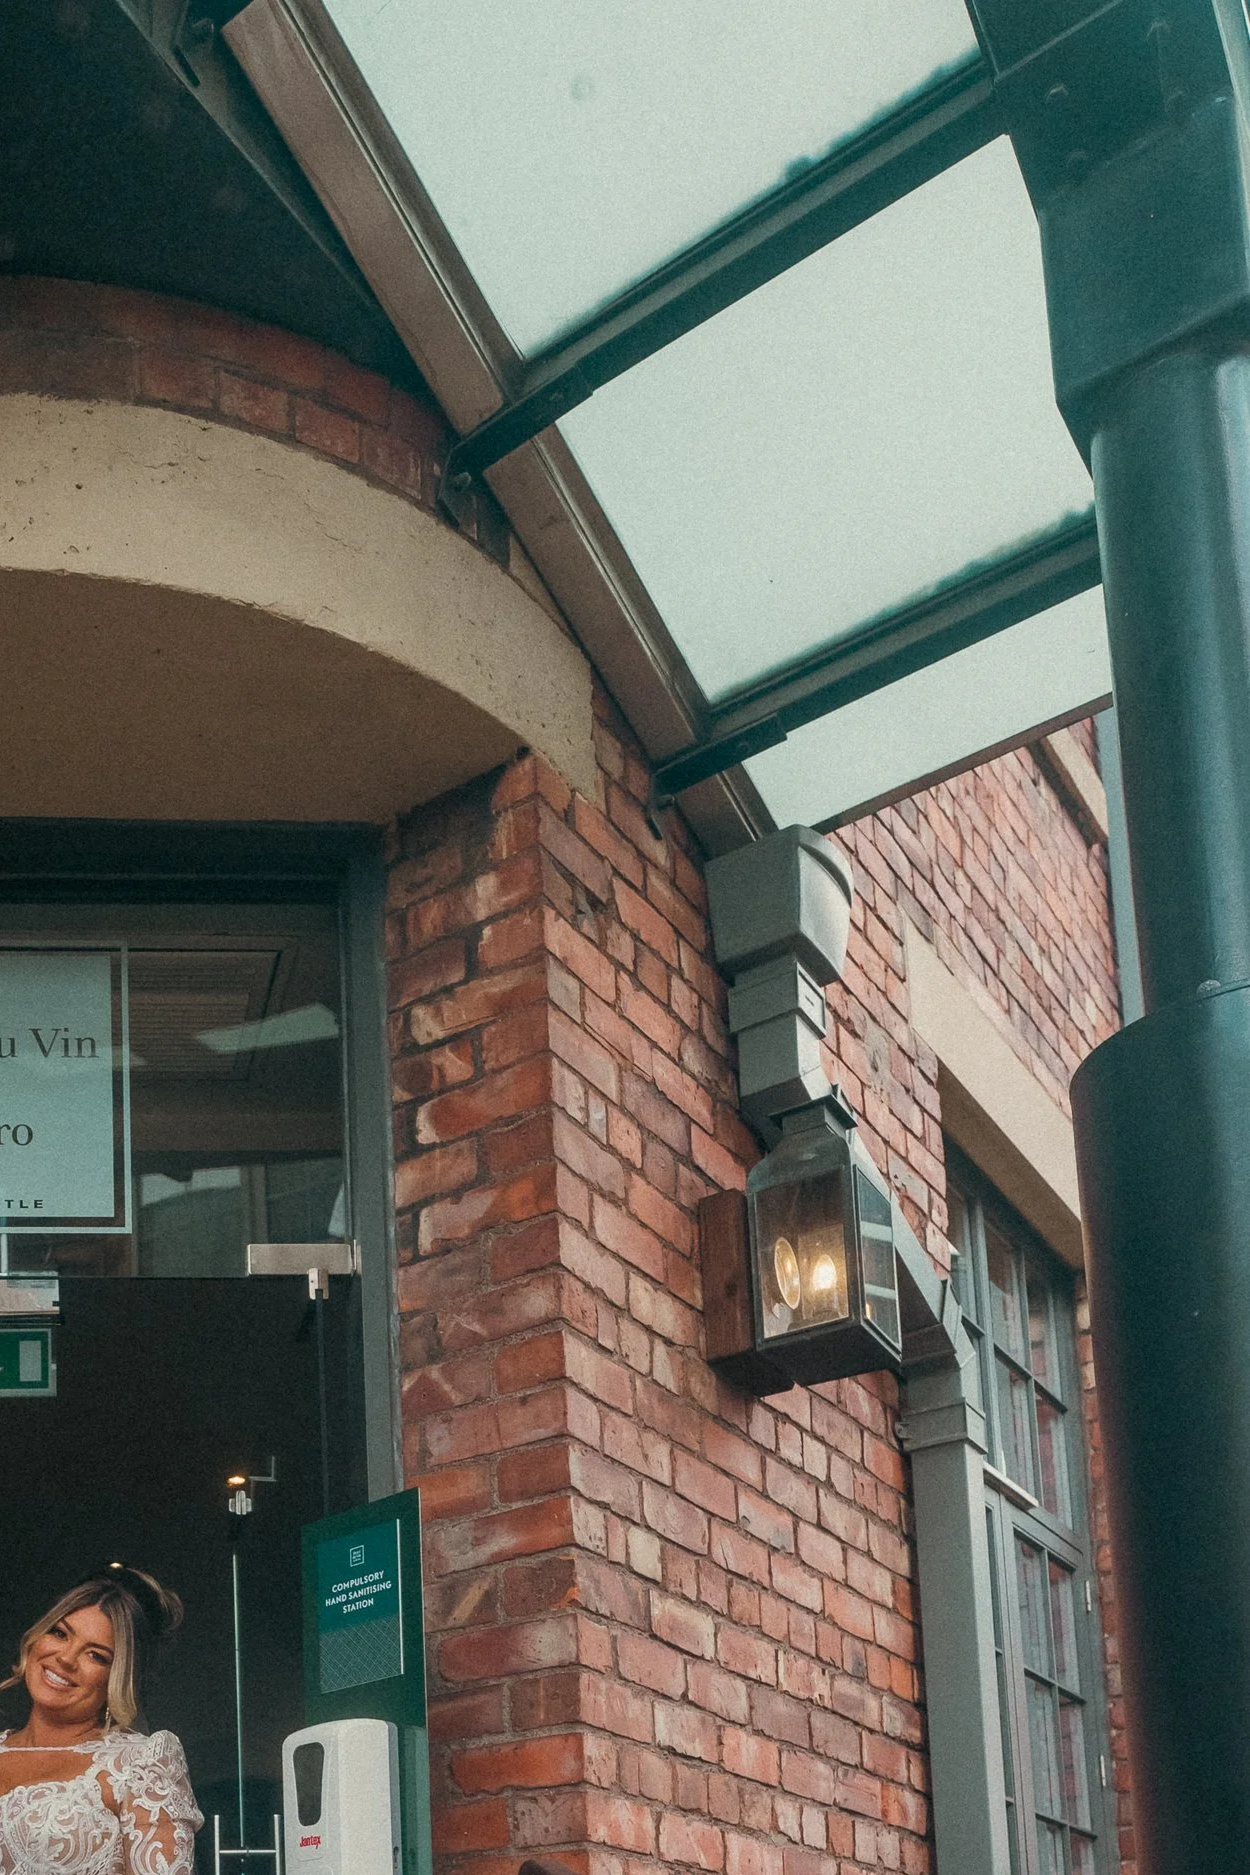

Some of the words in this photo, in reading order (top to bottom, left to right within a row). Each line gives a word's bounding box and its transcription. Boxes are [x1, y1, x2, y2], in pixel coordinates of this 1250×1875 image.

[28, 1027, 100, 1058] Vin
[331, 1570, 385, 1593] COMPULSORY
[325, 1593, 348, 1607] HAND
[348, 1580, 392, 1600] SANITISING
[342, 1597, 374, 1614] STATION
[299, 1835, 322, 1850] Jantex
